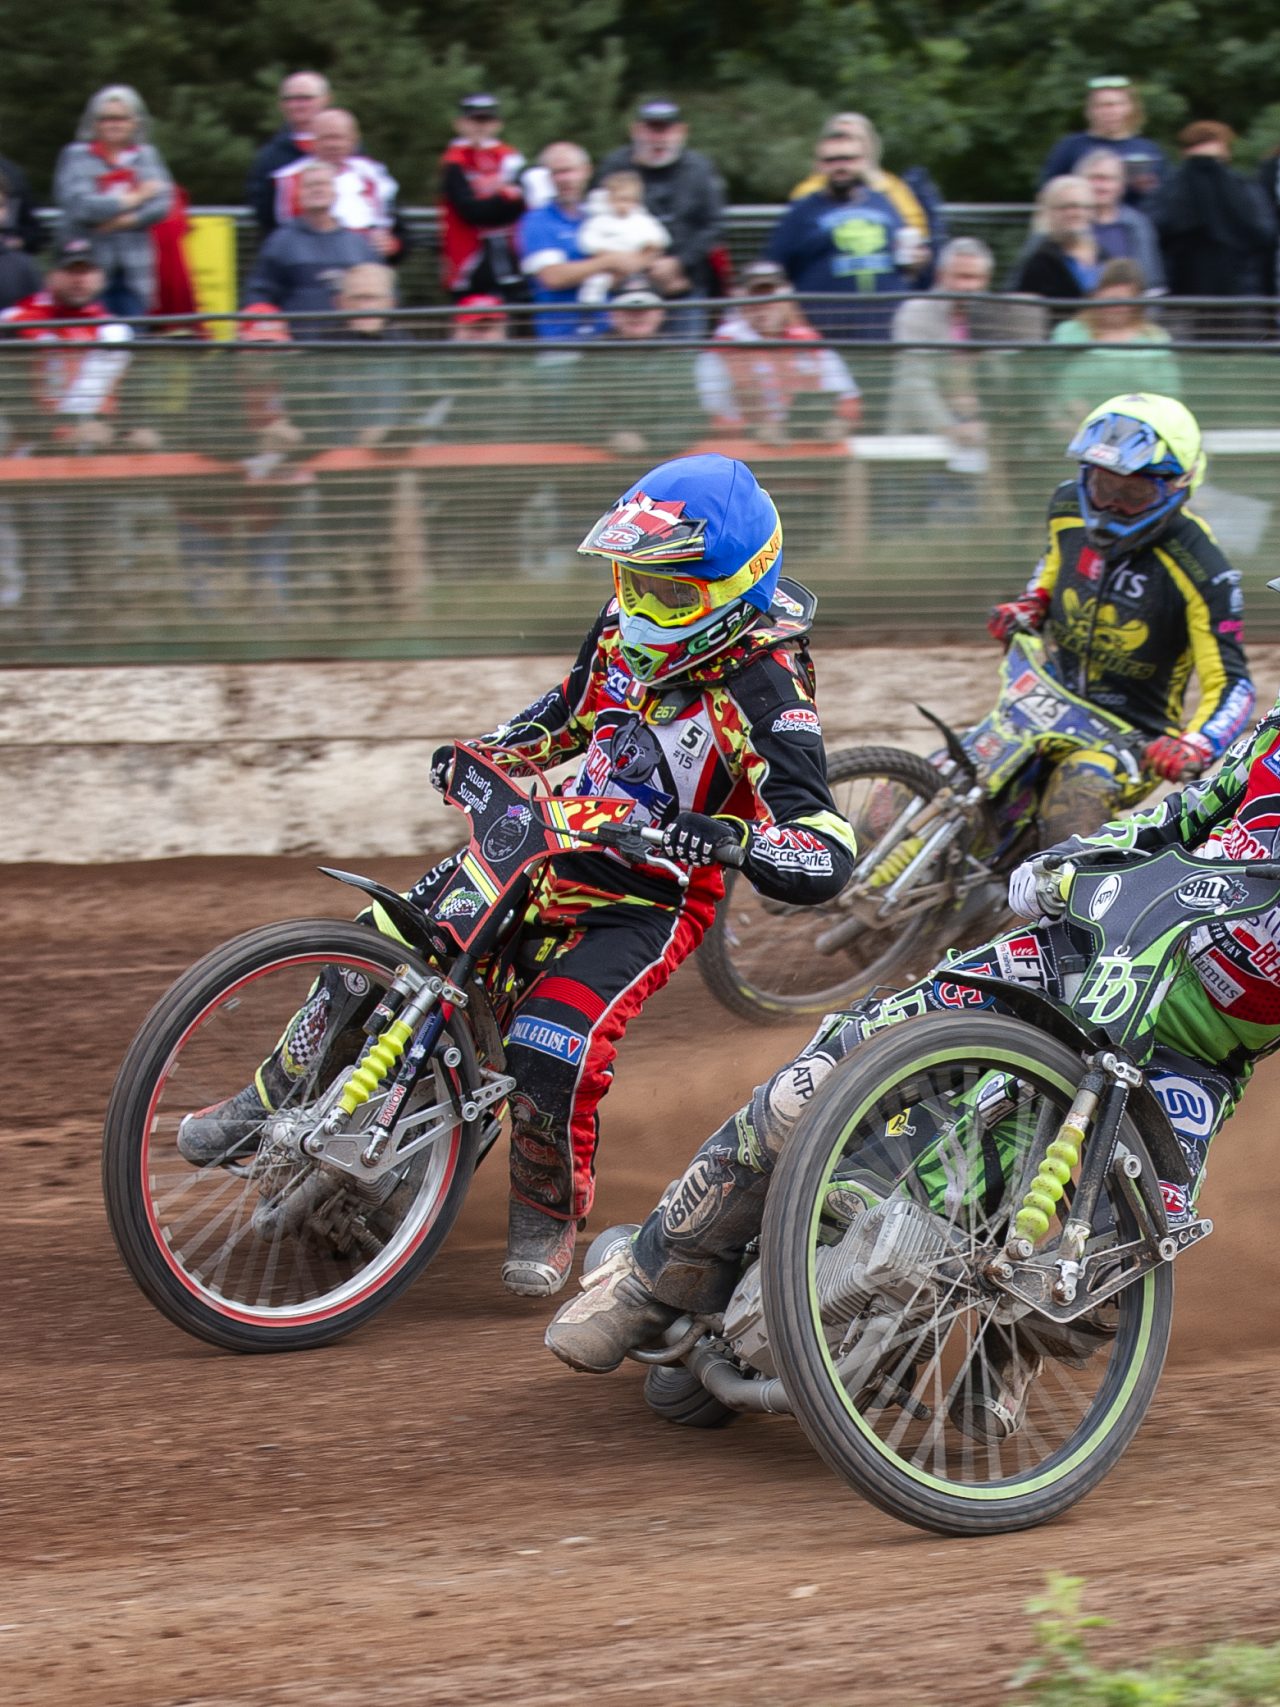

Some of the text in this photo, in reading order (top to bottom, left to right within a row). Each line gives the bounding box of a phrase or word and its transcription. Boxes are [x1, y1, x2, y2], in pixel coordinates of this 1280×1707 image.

[602, 529, 637, 543] STS
[654, 706, 677, 719] 267
[681, 726, 702, 750] 5
[673, 750, 694, 770] #15
[465, 765, 491, 792] Stuart
[457, 782, 488, 814] Suzanne
[537, 1027, 569, 1053] ELISE
[378, 1083, 407, 1128] MOTIVE
